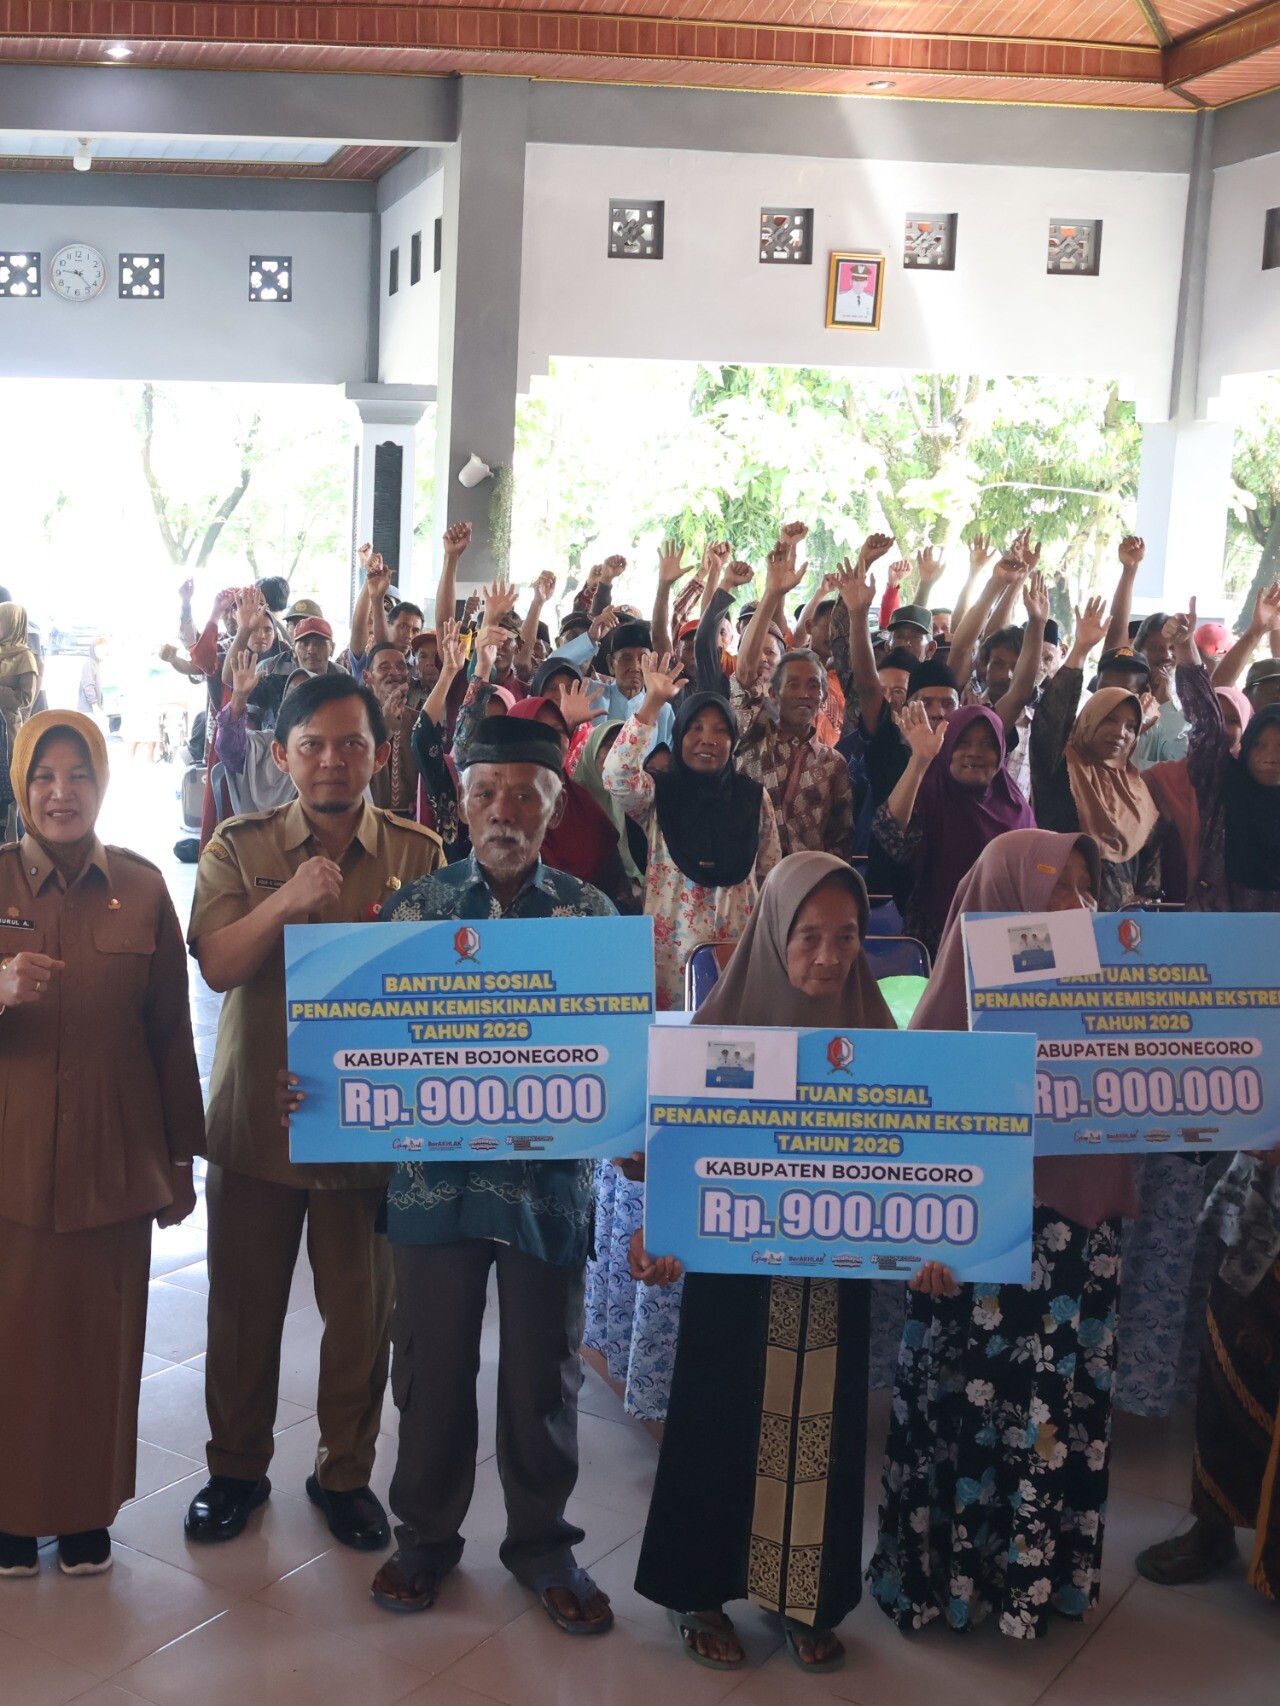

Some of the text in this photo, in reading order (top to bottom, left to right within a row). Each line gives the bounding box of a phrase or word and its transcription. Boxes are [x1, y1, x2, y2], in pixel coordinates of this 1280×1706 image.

[385, 973, 553, 992] BANTUAN SOSIAL
[1149, 966, 1208, 982] SOSIAL
[292, 996, 649, 1019] PENANGANAN KEMISKINAN EKSTREM
[975, 990, 1280, 1008] PENANGANAN KEMISKINAN EKSTRE
[411, 1022, 528, 1040] TAHUN 2026
[1085, 1014, 1190, 1031] TAHUN 2026
[344, 1049, 599, 1067] KABUPATEN BOJONEGORO
[1037, 1041, 1253, 1058] ABUPATEN BOJONEGORO
[344, 1077, 601, 1126] Rp. 900.000
[797, 1086, 929, 1105] TUAN SOSIAL
[1035, 1070, 1259, 1118] Rp. 900.000
[654, 1108, 1028, 1134] PENANGANAN KEMISKINAN EKSTREM
[778, 1135, 900, 1155] TAHUN 2026
[705, 1161, 973, 1183] KABUPATEN BOJONEGORO
[704, 1191, 974, 1242] Rp. 900.000
